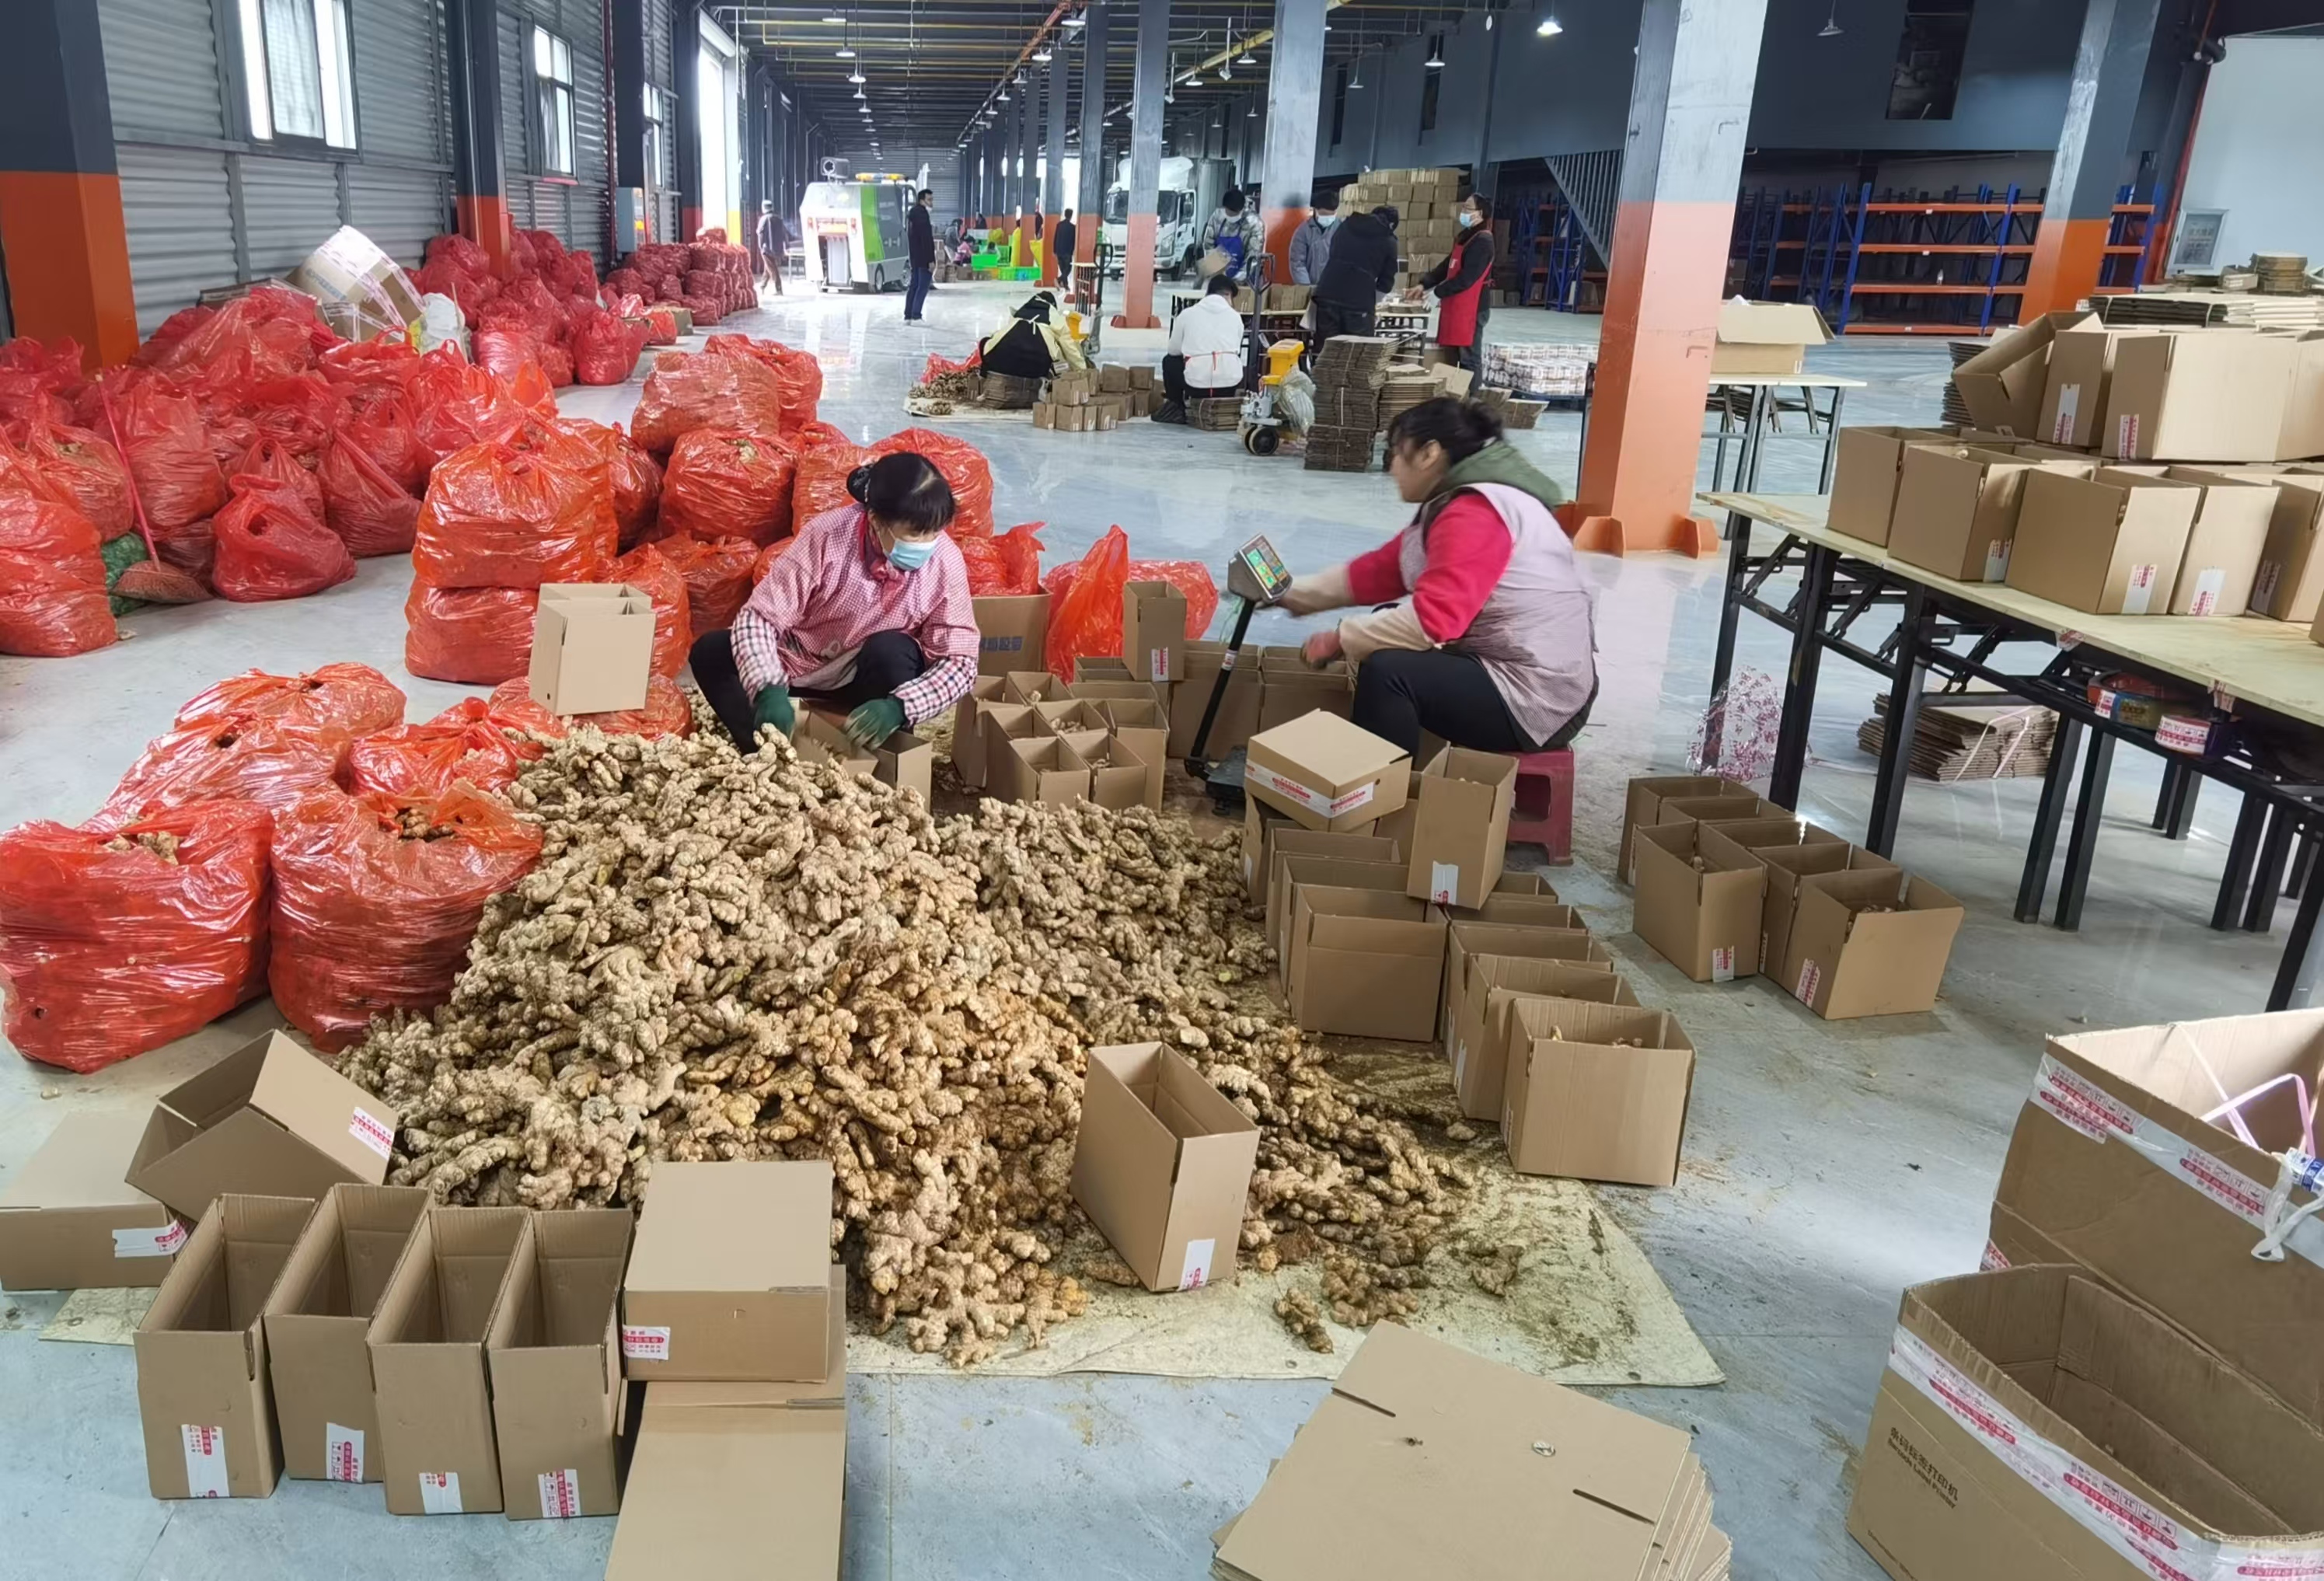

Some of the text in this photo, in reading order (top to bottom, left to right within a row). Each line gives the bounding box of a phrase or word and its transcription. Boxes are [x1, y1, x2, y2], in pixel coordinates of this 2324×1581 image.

[1887, 1437, 1956, 1509] Barcode Label Printer
[1890, 1426, 1958, 1501] 条码标签打印机
